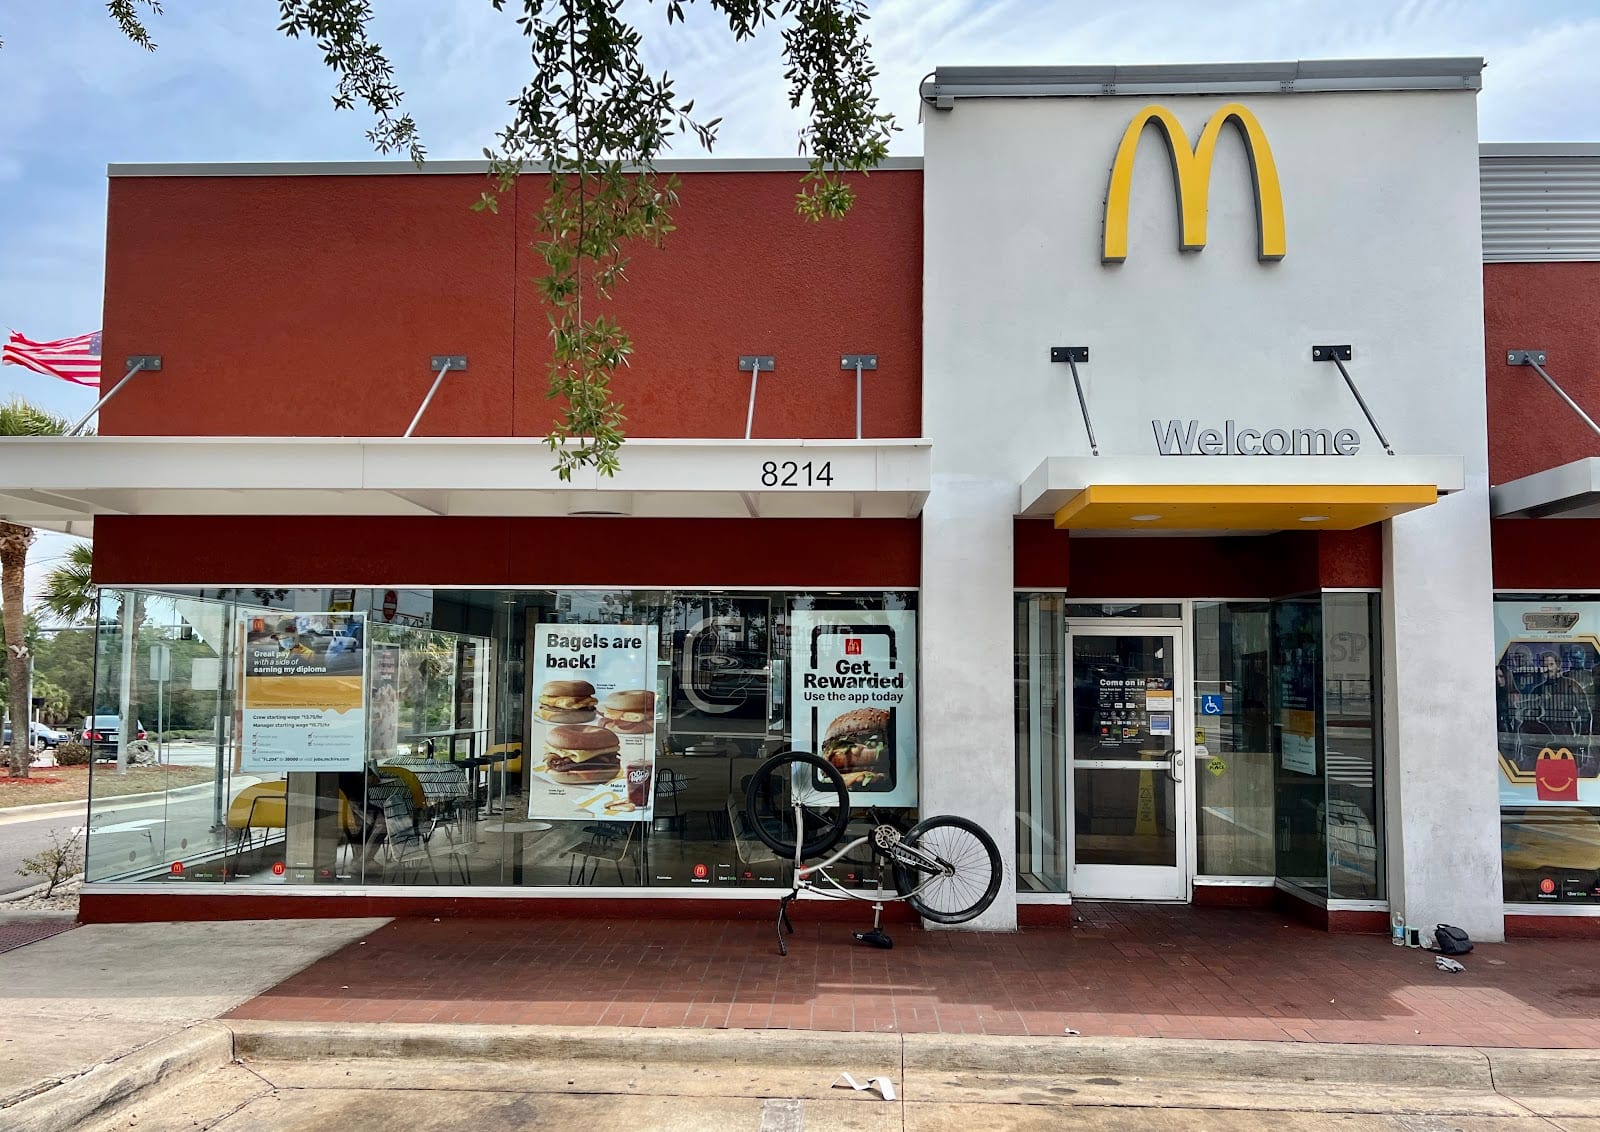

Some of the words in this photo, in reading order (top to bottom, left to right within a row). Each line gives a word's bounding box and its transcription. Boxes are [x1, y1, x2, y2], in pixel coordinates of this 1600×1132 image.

[1151, 419, 1361, 456] Welcome
[761, 461, 834, 486] 8214
[547, 633, 609, 652] Bagels
[612, 637, 642, 649] are
[546, 654, 596, 669] back!
[835, 659, 871, 675] Get
[254, 666, 282, 674] earning
[296, 666, 327, 674] diploma
[803, 673, 904, 689] Rewarded
[804, 691, 825, 701] Use
[828, 691, 846, 701] the
[848, 693, 870, 704] app
[871, 691, 904, 704] today
